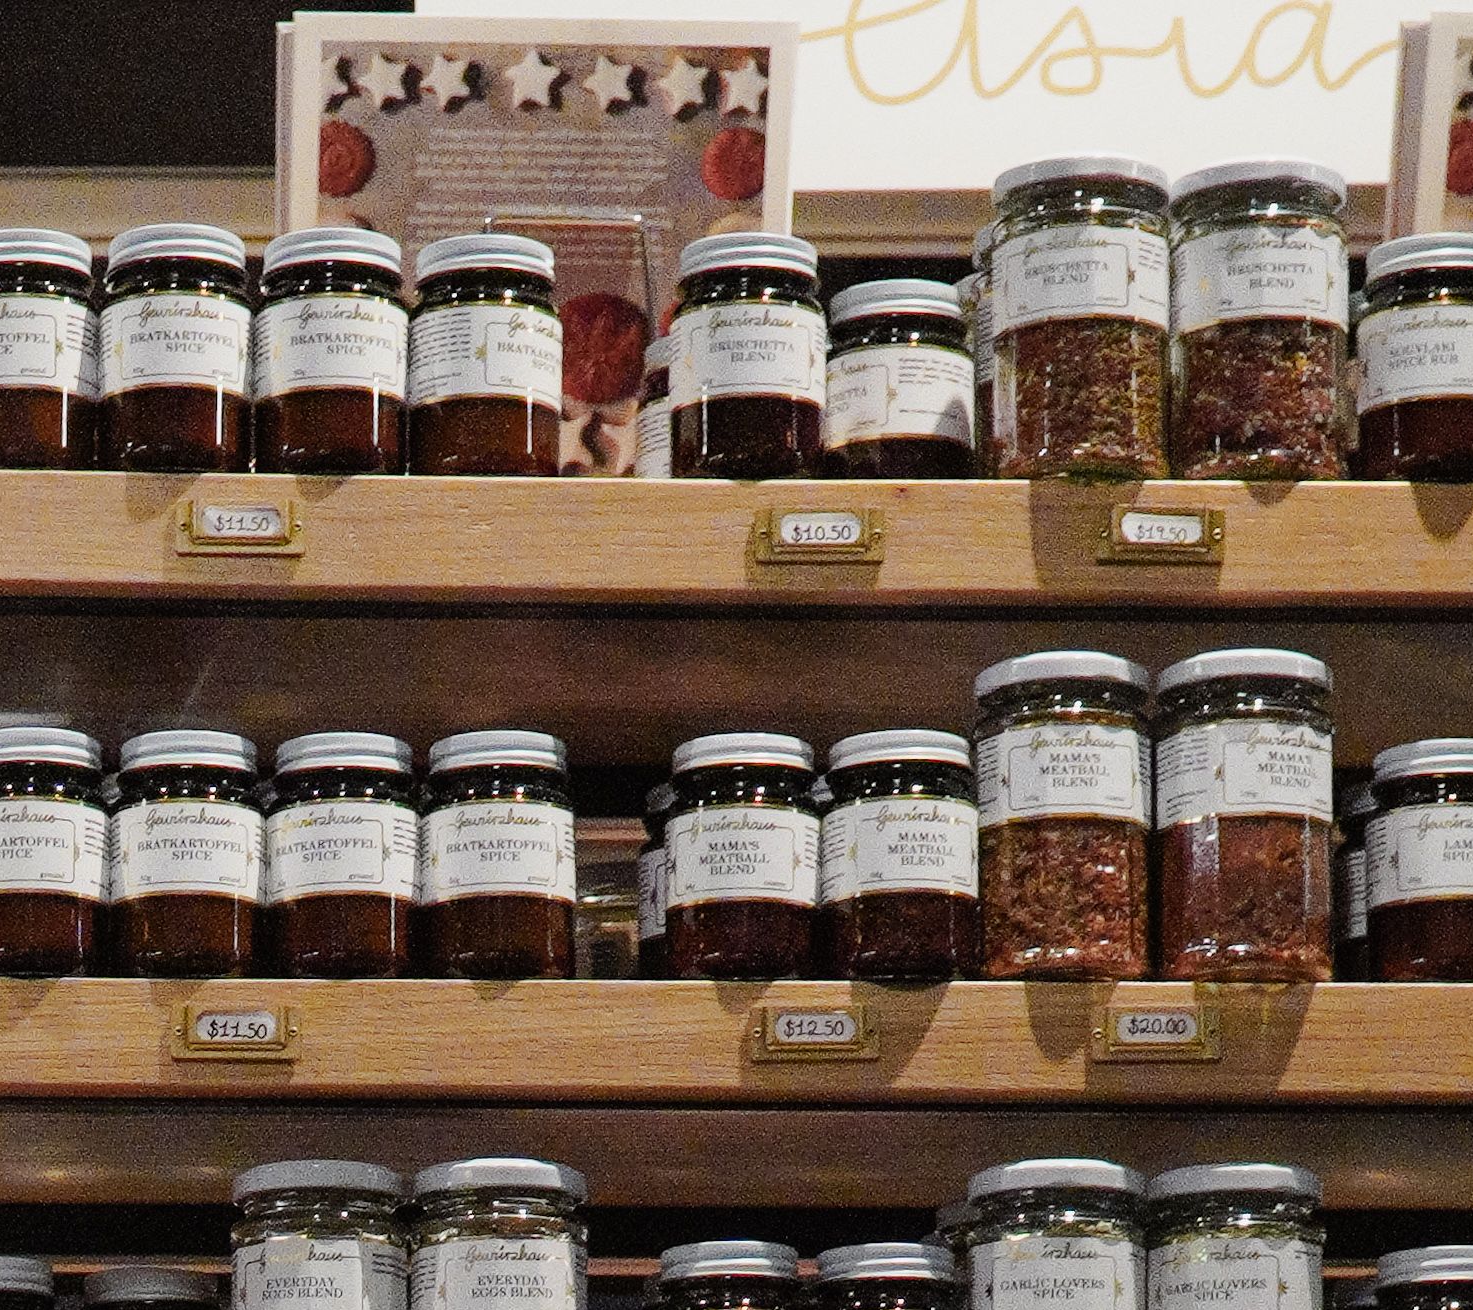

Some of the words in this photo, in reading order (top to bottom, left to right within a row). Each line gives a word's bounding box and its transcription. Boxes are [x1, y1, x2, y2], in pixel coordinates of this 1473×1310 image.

[164, 341, 207, 355] SPICE
[708, 337, 795, 353] BRUSCHETTA
[730, 351, 777, 363] BLEND
[213, 514, 271, 534] $11.50
[790, 524, 852, 543] $10.50
[1048, 752, 1102, 765] MAMA'S
[1038, 764, 1110, 777] MEATBALL
[1051, 776, 1099, 789] BLEND
[137, 837, 244, 854] BRATKARTOFFEL
[707, 841, 760, 853] MAMA'S
[170, 849, 213, 862] SPICE
[698, 853, 771, 865] MEATBALL
[709, 864, 757, 876] BLEND
[207, 1019, 268, 1040] $11.50
[1126, 1017, 1188, 1035] $20.00
[476, 1274, 548, 1287] EVERYDAY
[1000, 1278, 1050, 1291] GARLIC
[1052, 1277, 1106, 1290] LOVERS
[470, 1286, 508, 1299] EGGS
[510, 1286, 553, 1299] BLEND
[1032, 1288, 1075, 1300] SPICE
